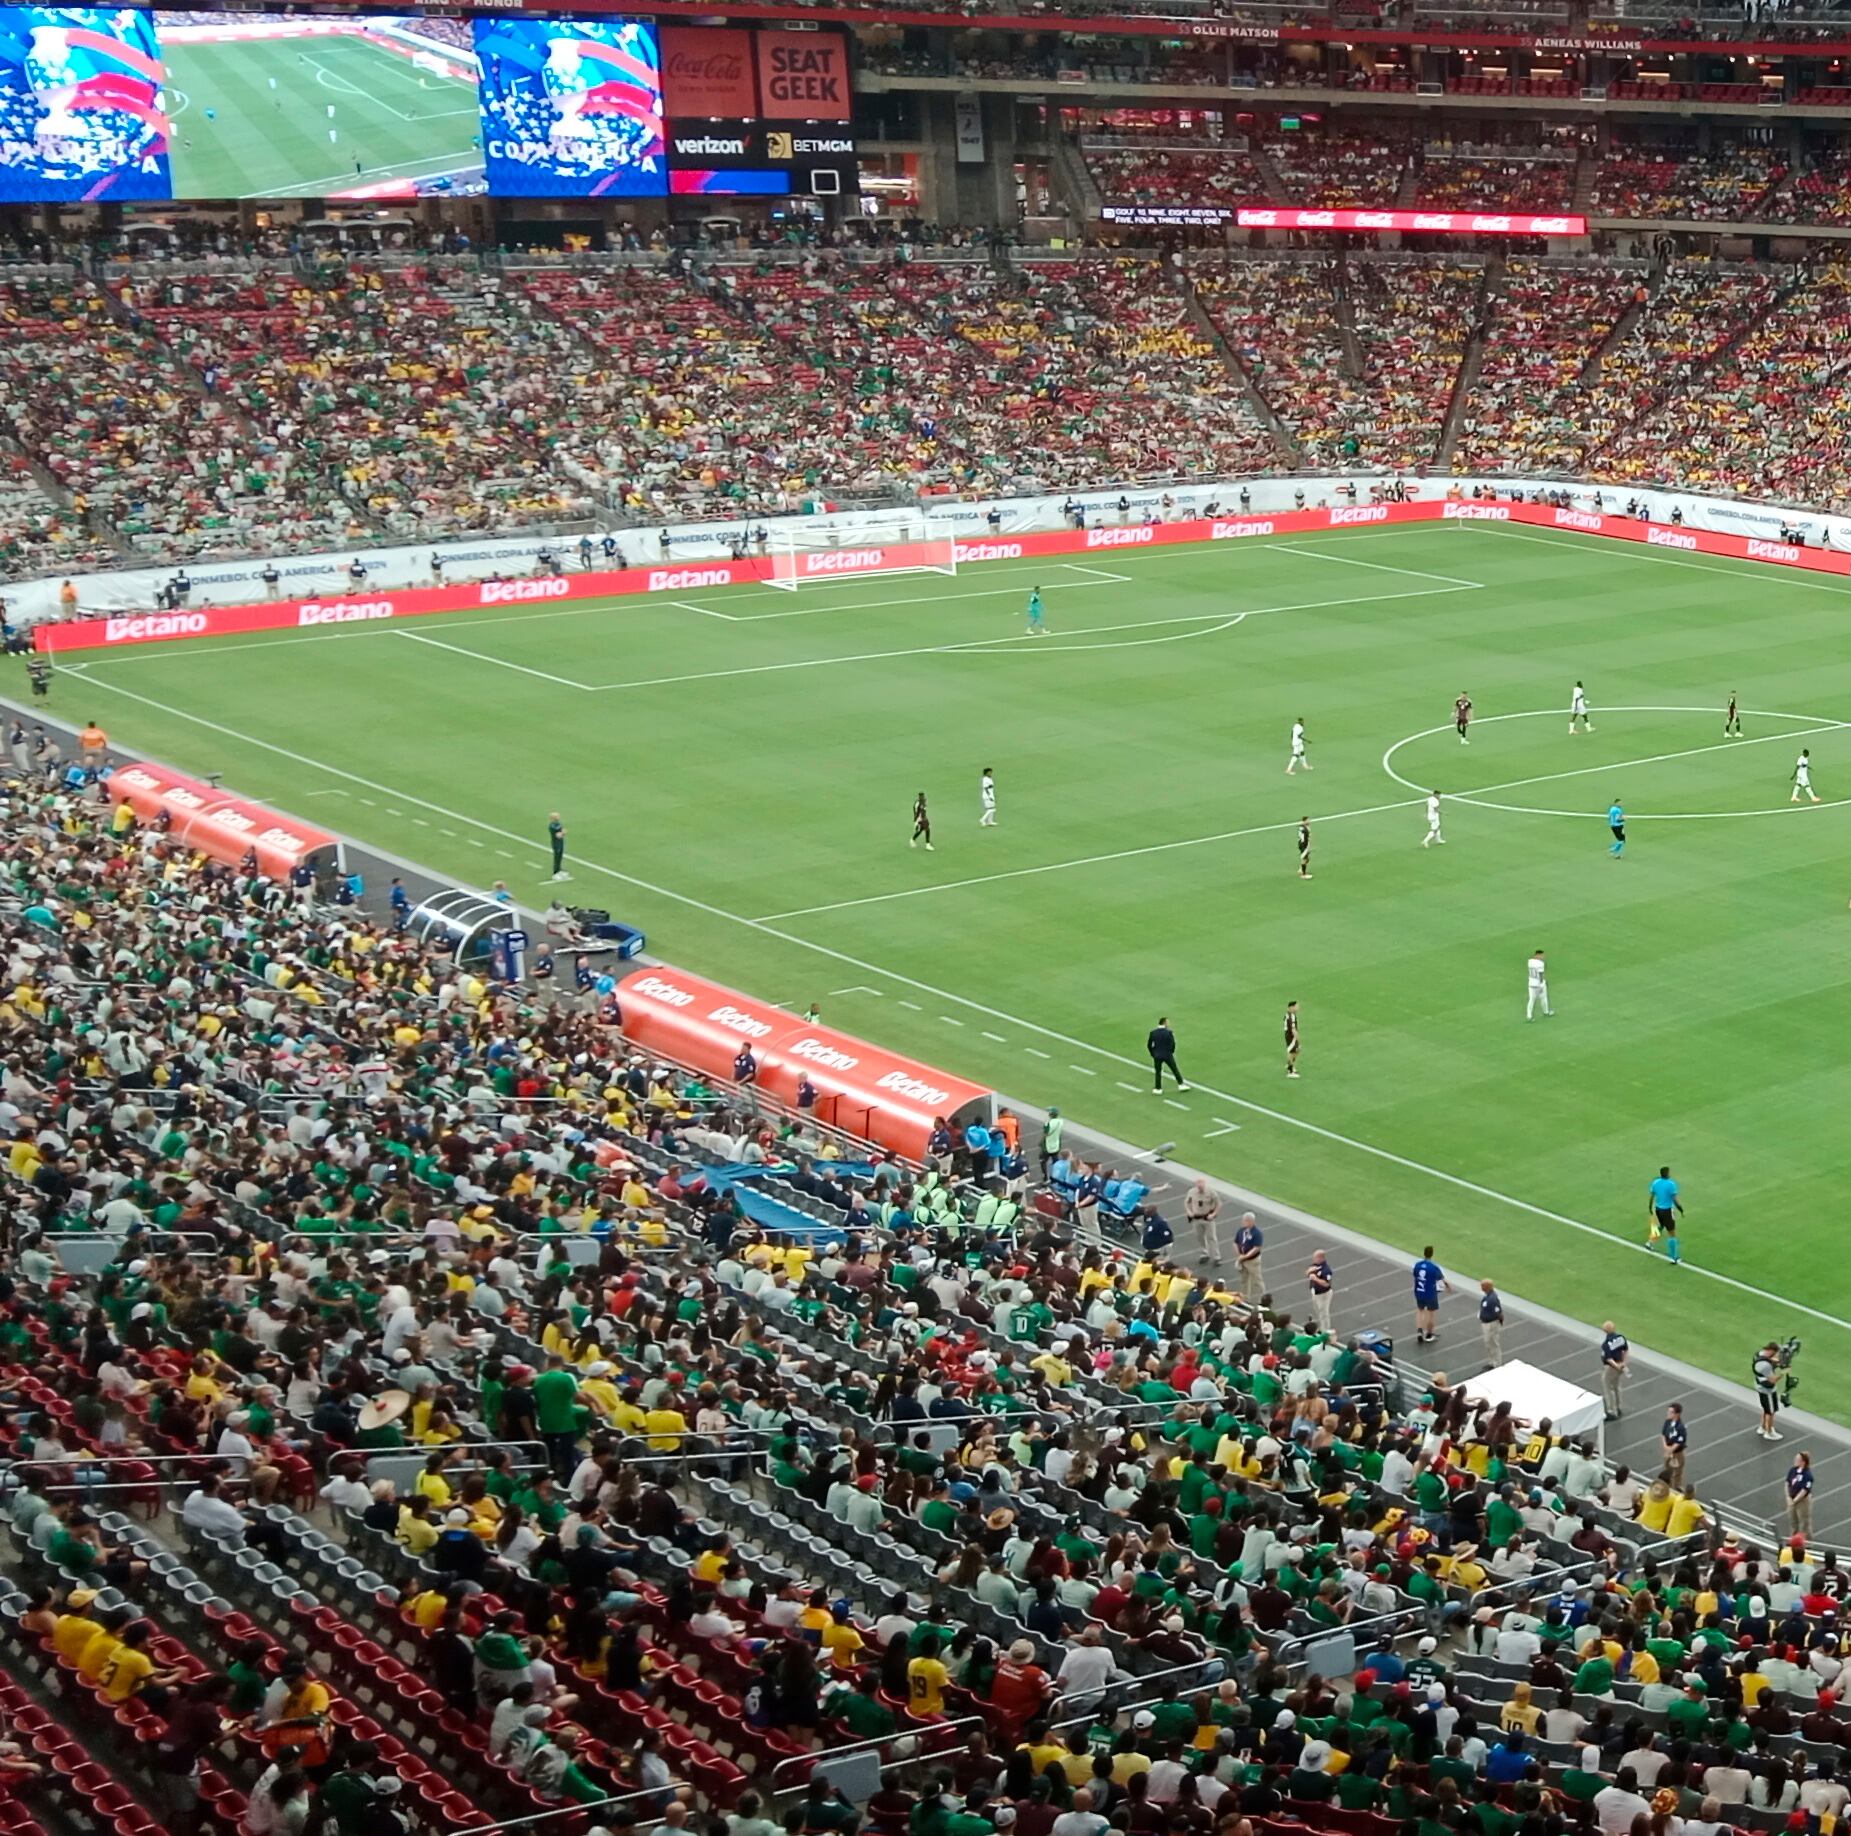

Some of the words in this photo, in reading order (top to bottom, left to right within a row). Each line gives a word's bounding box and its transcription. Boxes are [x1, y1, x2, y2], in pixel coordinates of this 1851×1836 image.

[1193, 27, 1227, 36] OLLIE
[1230, 28, 1279, 38] MATSON
[1535, 39, 1582, 48] AENEAS
[1584, 40, 1641, 50] WILLIAMS
[771, 46, 834, 74] SEAT
[769, 77, 840, 102] GEEK
[675, 136, 744, 155] verizon
[793, 139, 853, 152] BETMGM
[1087, 527, 1154, 547] Betano
[1647, 527, 1697, 550] Betano
[1747, 539, 1799, 562] Betano
[480, 578, 570, 603] Betano
[648, 569, 732, 592] Betano
[298, 600, 394, 626] Betano
[105, 612, 207, 641] Betano
[632, 977, 695, 1007] Betano
[708, 1006, 772, 1039] Betano
[789, 1038, 859, 1072] Betano
[877, 1070, 949, 1105] Betano
[1015, 1316, 1028, 1332] 10
[911, 1675, 929, 1700] 19
